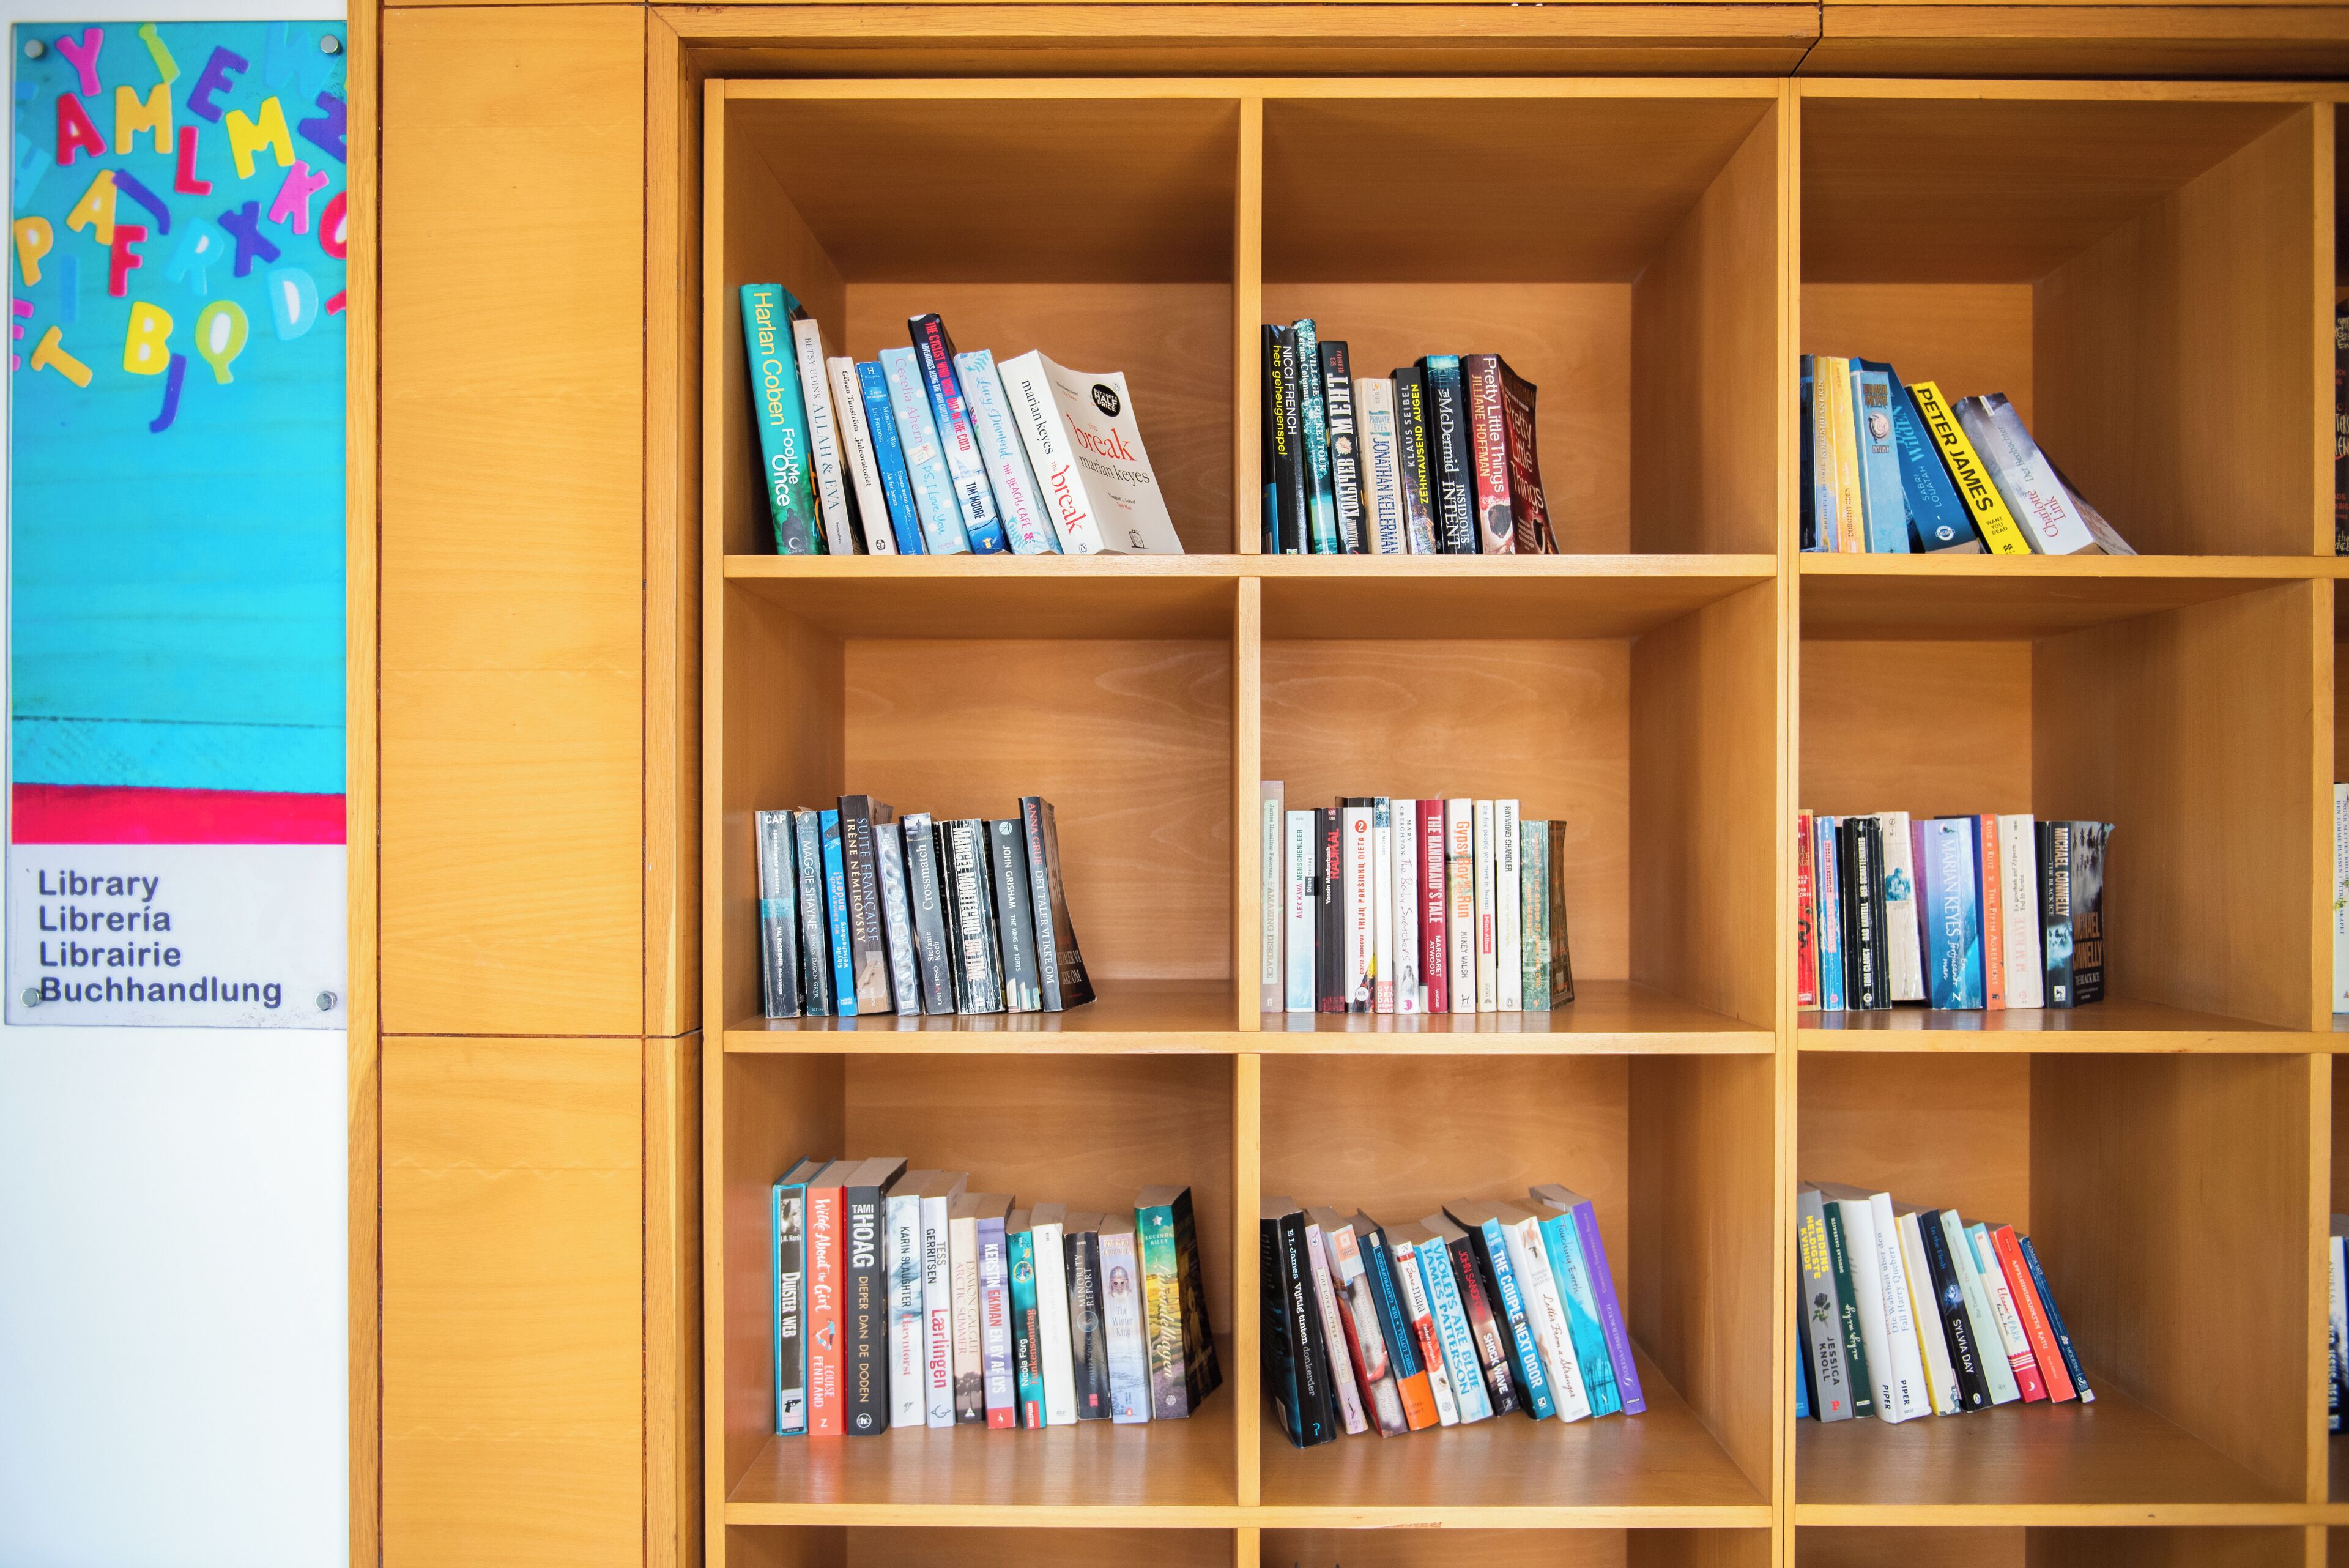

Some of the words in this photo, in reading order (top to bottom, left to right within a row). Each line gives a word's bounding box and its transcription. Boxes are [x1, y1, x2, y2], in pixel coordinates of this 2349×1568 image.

[754, 292, 777, 355] Harlan
[1272, 345, 1281, 367] het
[1283, 346, 1293, 377] NICCI
[763, 359, 785, 425] Coben
[1094, 392, 1117, 406] HALF
[1438, 388, 1450, 398] Val
[1472, 374, 1482, 420] JILLIANE
[1483, 357, 1497, 403] Pretty
[895, 358, 912, 403] Cecelia
[907, 406, 924, 444] Ahern
[1021, 379, 1042, 422] marian
[1036, 420, 1054, 455] keyes
[1097, 399, 1116, 412] PRICE
[1272, 370, 1288, 455] geheugenspel
[1285, 379, 1297, 435] FRENCH
[1401, 385, 1412, 425] SEIBEL
[1411, 384, 1421, 422] AUGEN
[1066, 412, 1137, 461] break
[1438, 396, 1459, 473] McDermid
[1487, 405, 1500, 440] Little
[813, 404, 831, 457] ALLAH
[825, 481, 839, 510] EVA
[1373, 437, 1393, 491] JONATHAN
[1405, 429, 1416, 467] KLAUS
[1414, 425, 1429, 504] ZEHNTAUSEND
[1475, 423, 1490, 477] HOFFMAN
[1917, 387, 1958, 447] PETER
[1949, 448, 1994, 512] JAMES
[772, 455, 790, 506] Once
[965, 481, 976, 492] TIM
[1078, 455, 1115, 480] marian
[1114, 465, 1150, 487] keyes
[1490, 445, 1504, 492] Things
[970, 493, 985, 519] MOORE
[1050, 464, 1088, 535] break
[1442, 481, 1461, 549] INTENT
[1455, 484, 1470, 544] INSIDIOUS
[2026, 489, 2058, 539] Charlotte
[2046, 494, 2067, 524] Link
[1378, 490, 1399, 554] KELLERMAN
[765, 814, 787, 824] CAP
[857, 818, 870, 856] SUITE
[1028, 803, 1040, 834] ANNA
[1427, 815, 1441, 834] THE
[802, 841, 815, 885] MAGGIE
[1003, 845, 1011, 869] JOHN
[1032, 836, 1043, 865] GRUE
[1428, 834, 1442, 898] HANDMAID'S
[1942, 839, 1957, 893] MARIAN
[2055, 828, 2068, 868] MICHAEL
[39, 869, 158, 902] Library
[916, 844, 933, 910] Crossmatch
[1005, 871, 1016, 908] GRISHAM
[1036, 870, 1045, 890] DET
[2055, 871, 2069, 916] CONNELLY
[39, 905, 171, 931] Librería
[805, 887, 817, 929] SHAYNE
[862, 864, 878, 942] FRANÇAISE
[1037, 892, 1048, 927] TALER
[1429, 899, 1442, 924] TALE
[1945, 895, 1961, 937] KEYES
[1041, 929, 1050, 938] VI
[39, 941, 181, 967] Librairie
[1043, 940, 1053, 968] IKKE
[40, 976, 281, 1008] Buchhandlung
[1046, 969, 1055, 984] OM
[852, 1204, 874, 1214] TAMI
[853, 1214, 874, 1268] HOAG
[900, 1226, 909, 1255] KARIN
[926, 1228, 937, 1284] GERRITSEN
[935, 1241, 947, 1266] TESS
[1800, 1227, 1812, 1271] KVINDE
[1806, 1215, 1821, 1279] HELDIGSTE
[1814, 1218, 1830, 1273] VERDENS
[900, 1255, 911, 1308] SLAUGHTER
[984, 1243, 1000, 1288] KERSTIN
[1074, 1254, 1086, 1307] MINORITY
[1493, 1249, 1508, 1274] THE
[859, 1276, 869, 1310] DIEPER
[1083, 1268, 1094, 1306] REPORT
[1500, 1277, 1521, 1322] COUPLE
[859, 1315, 869, 1339] DAN
[987, 1290, 1002, 1327] EKMAN
[1111, 1315, 1133, 1326] Winter
[1433, 1243, 1457, 1309] VIOLETS
[1451, 1316, 1468, 1342] ARE
[1461, 1348, 1480, 1391] BLUE
[859, 1344, 869, 1358] DE
[930, 1308, 950, 1388] Lærlingen
[1019, 1338, 1028, 1359] Förg
[1026, 1309, 1038, 1385] Funkensonntag
[1297, 1312, 1307, 1345] tinten
[1303, 1345, 1316, 1397] donkerder
[1440, 1306, 1469, 1395] PATTERSON
[1513, 1318, 1532, 1352] NEXT
[1953, 1318, 1969, 1354] SYLVIA
[1961, 1353, 1975, 1374] DAY
[1020, 1361, 1029, 1388] Nicola
[1483, 1332, 1501, 1367] SHOCK
[1494, 1362, 1508, 1394] WAVE
[1524, 1354, 1543, 1389] DOOR
[1819, 1342, 1830, 1383] KNOLL
[1827, 1336, 1839, 1386] JESSICA
[812, 1356, 824, 1408] PENTLAND
[823, 1365, 834, 1398] LOUISE
[859, 1362, 869, 1402] DODEN
[1882, 1384, 1891, 1410] PIPER
[1900, 1380, 1910, 1406] PIPER
